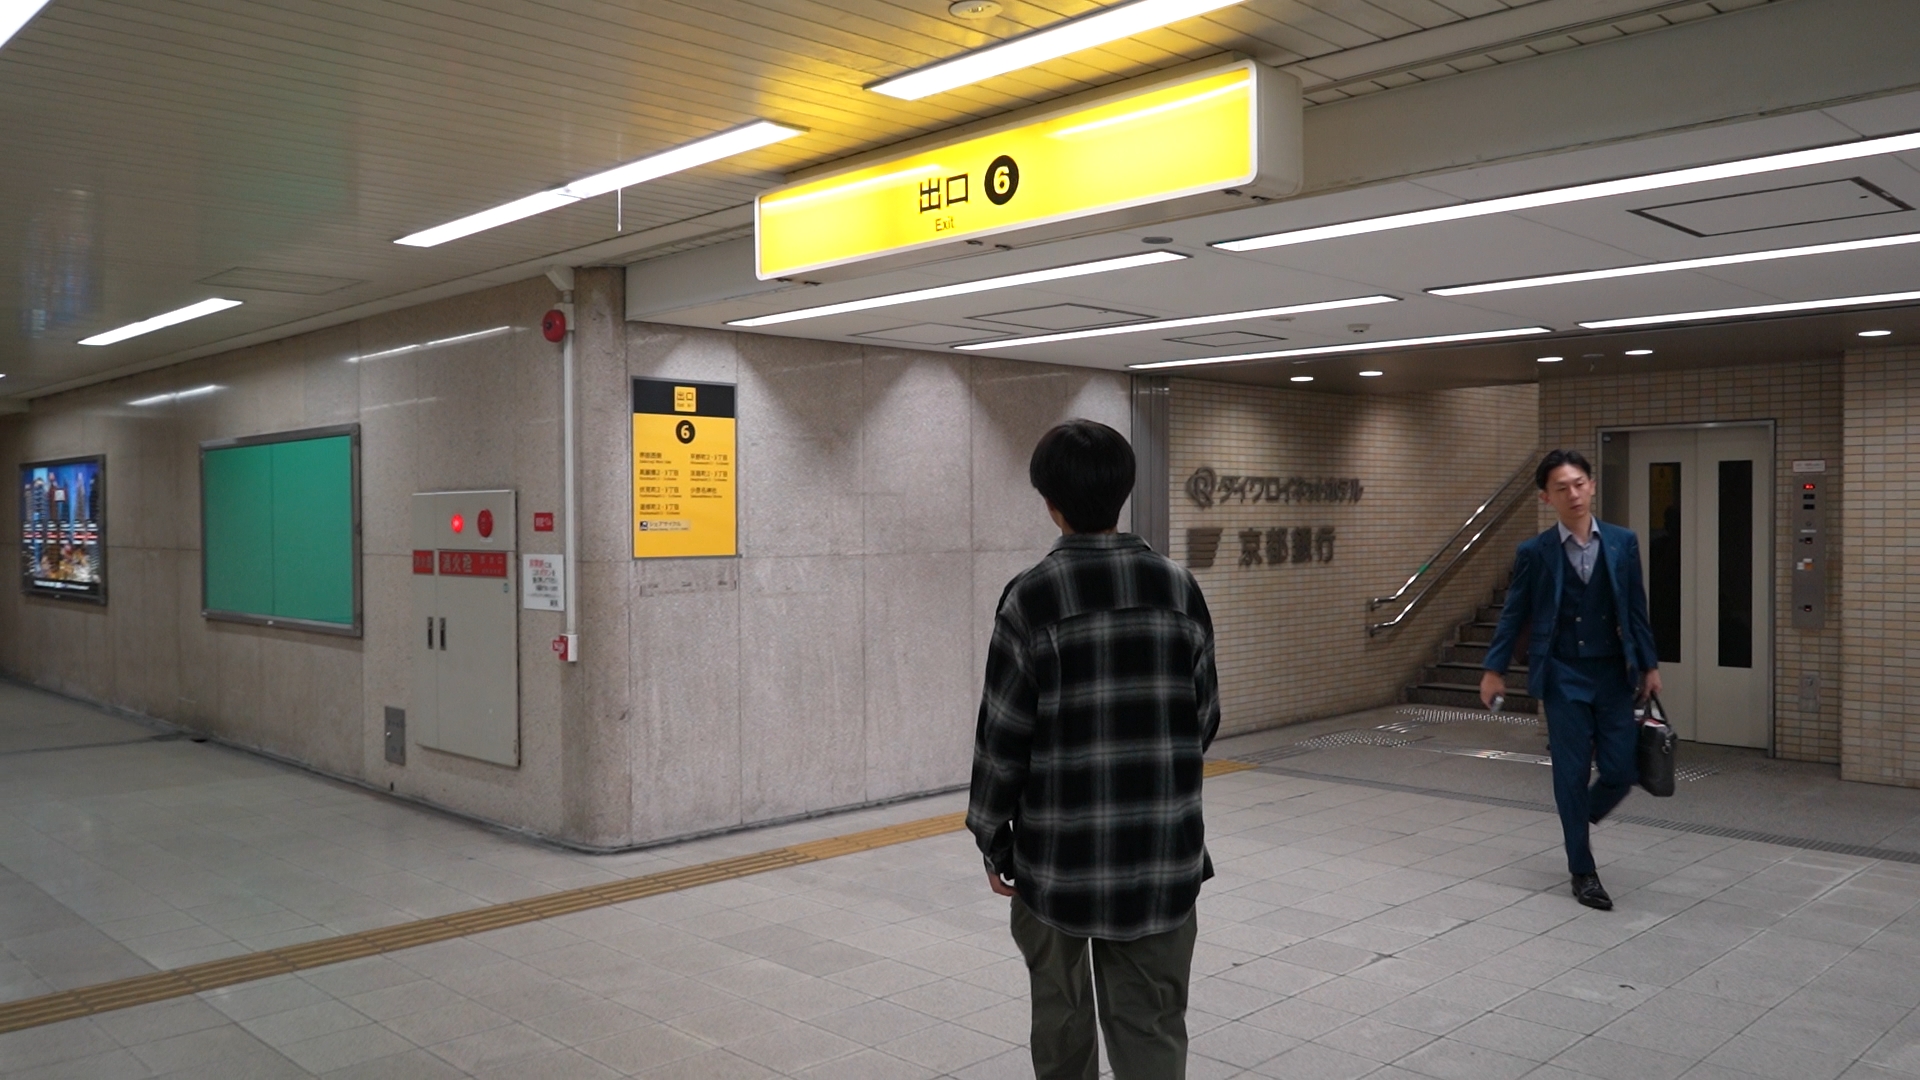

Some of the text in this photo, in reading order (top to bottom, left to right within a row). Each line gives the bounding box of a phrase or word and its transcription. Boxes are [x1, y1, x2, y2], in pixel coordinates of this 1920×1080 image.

[919, 165, 1011, 214] 出口 6
[935, 216, 955, 232] Exit
[676, 391, 694, 401] 出口
[680, 424, 691, 439] 6
